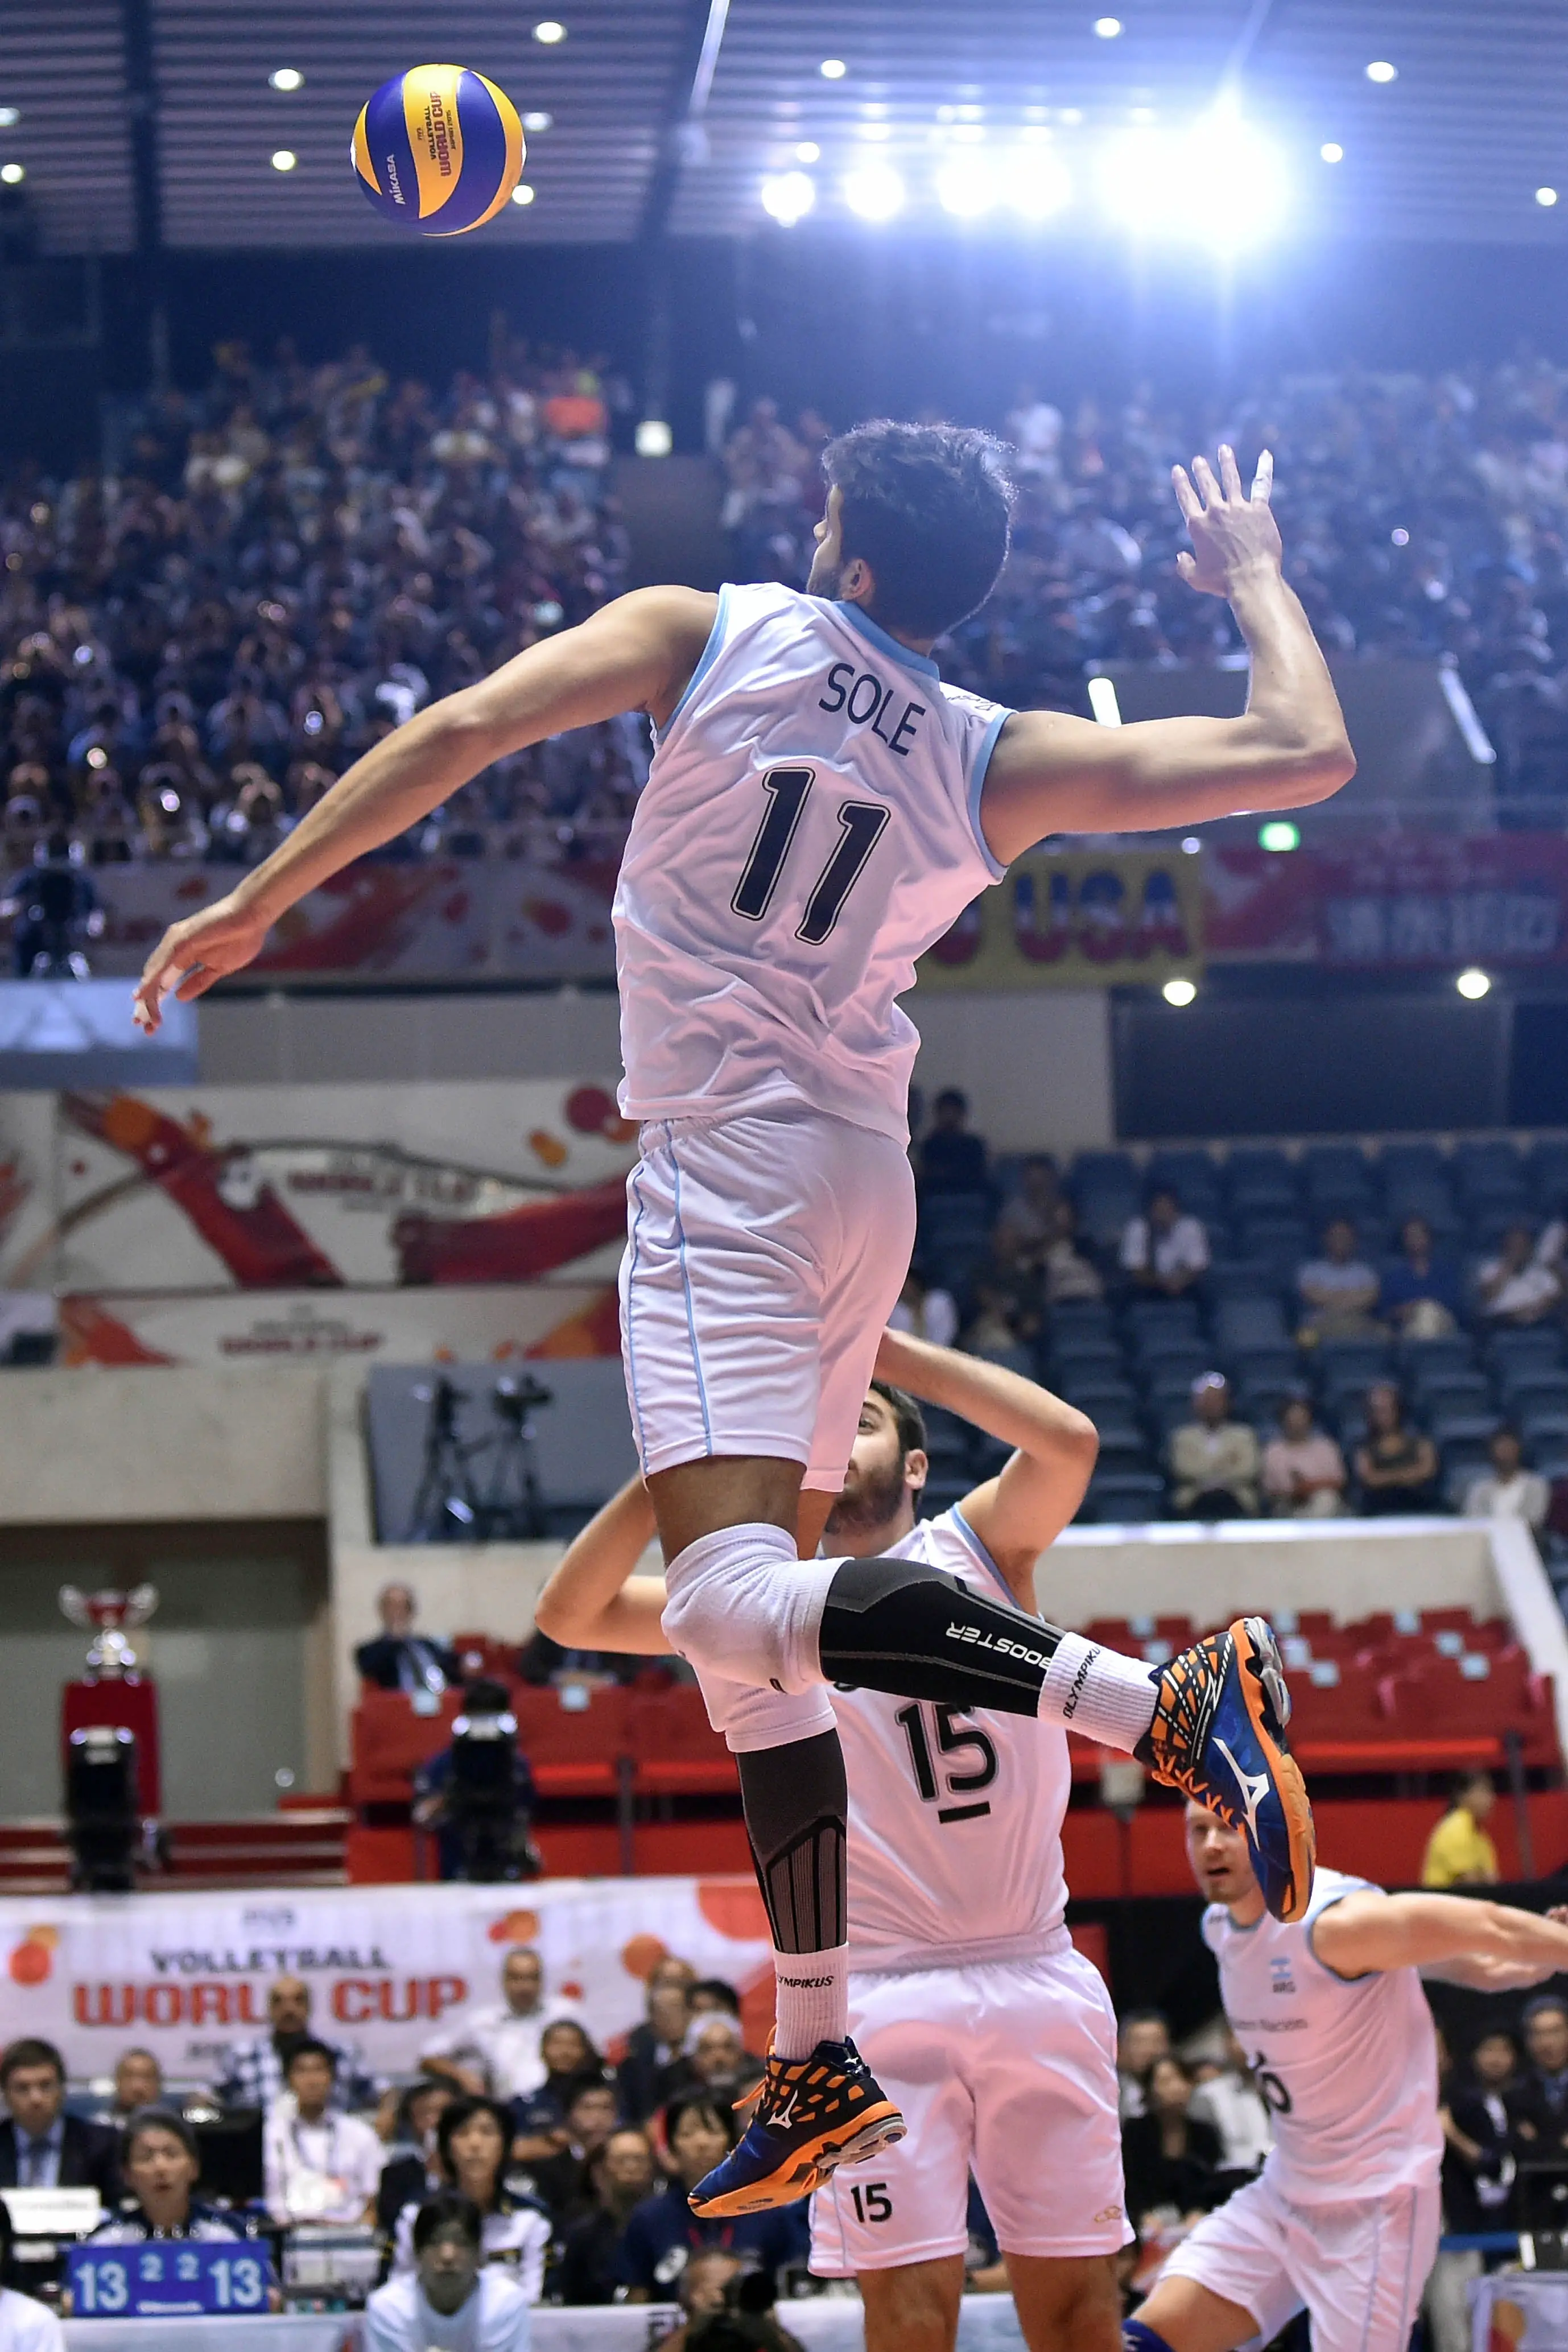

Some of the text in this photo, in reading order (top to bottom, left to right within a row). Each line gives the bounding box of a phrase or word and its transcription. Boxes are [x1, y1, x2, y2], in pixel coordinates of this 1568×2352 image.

[425, 106, 436, 159] VOLLEYBALL
[430, 92, 451, 176] WORLD CUP
[387, 154, 406, 204] MIKASA
[818, 662, 926, 756] SOLE
[731, 766, 891, 945] 11
[1014, 869, 1190, 963] USA
[1063, 1647, 1101, 1719] OLYMPIKU
[895, 1700, 999, 1802] 15
[151, 1947, 390, 1973] VOLLEYBALL
[777, 1974, 834, 1988] YMPIKUS
[74, 1975, 468, 2027] WORL CUP
[851, 2182, 892, 2223] 15
[75, 2252, 262, 2311] 13 2 2 13
